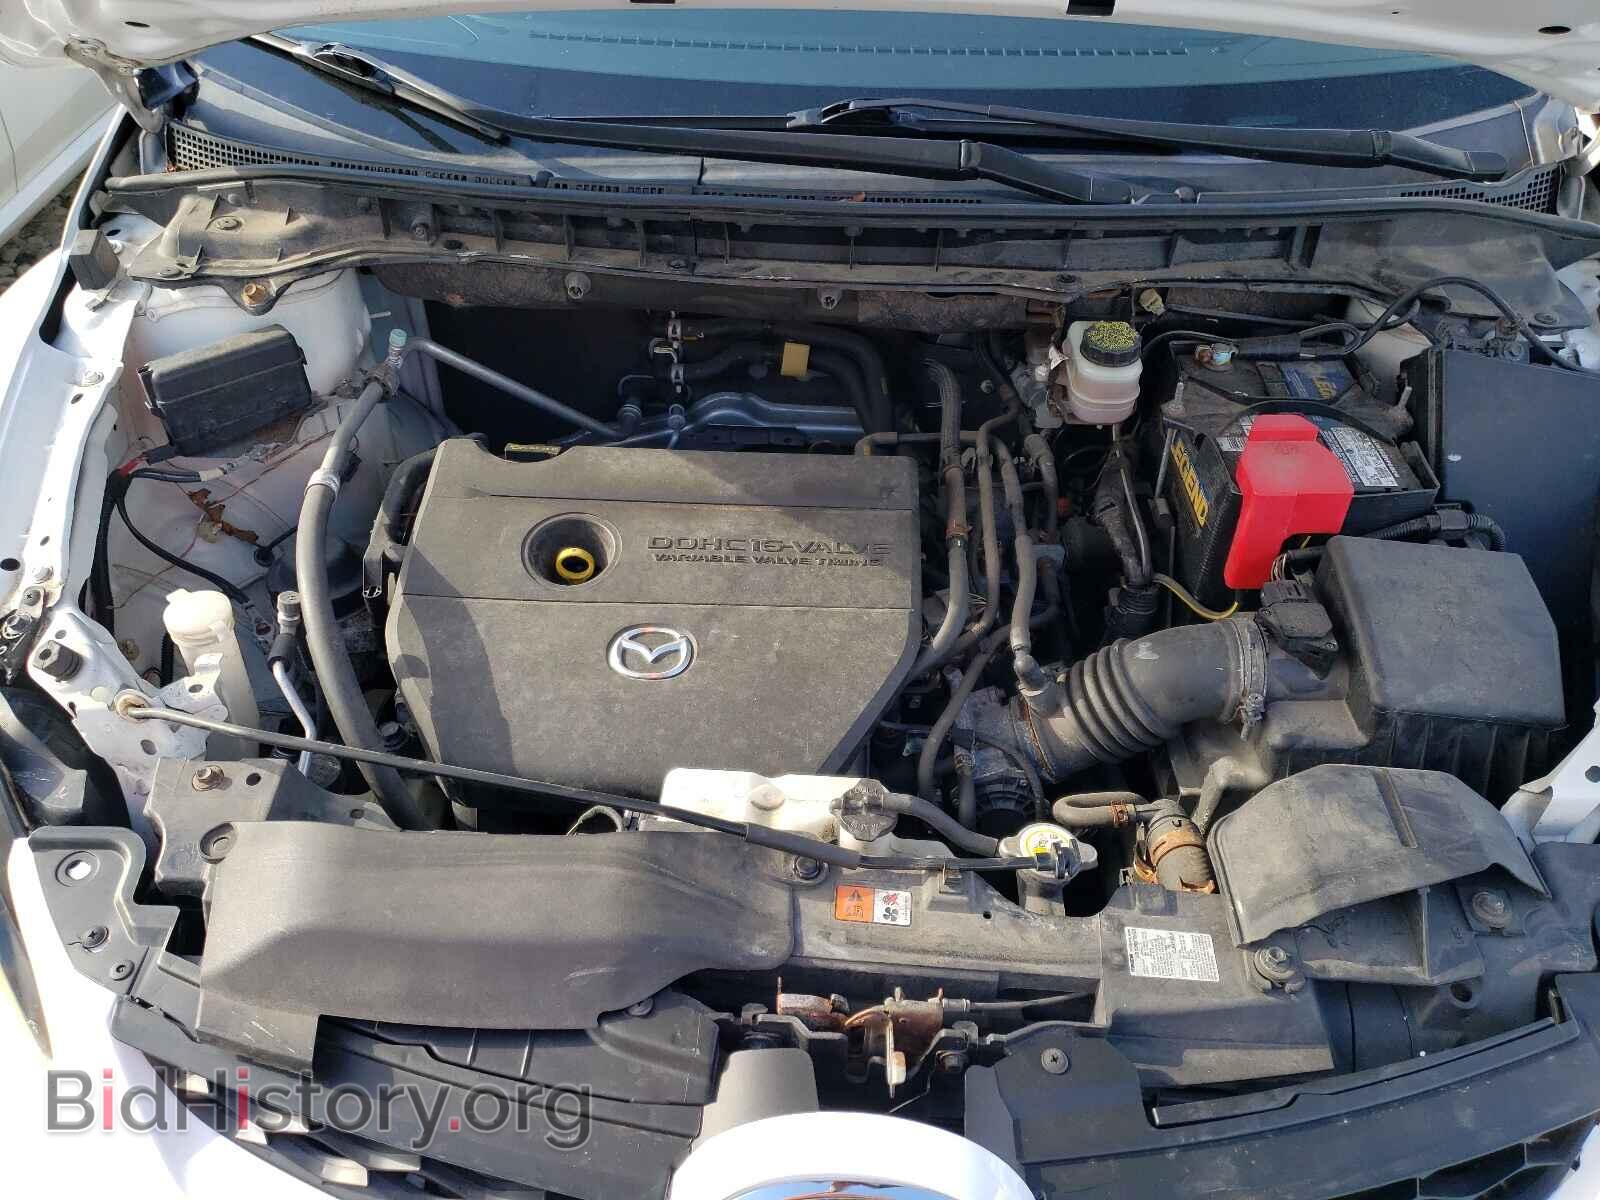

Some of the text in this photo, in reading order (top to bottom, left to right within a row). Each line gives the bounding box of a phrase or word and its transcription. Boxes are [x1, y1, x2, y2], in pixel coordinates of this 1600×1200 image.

[1171, 439, 1209, 528] EGEND
[647, 536, 892, 556] DOHC 16-VALVE
[653, 552, 883, 568] VARIABLE VALVE TIMING
